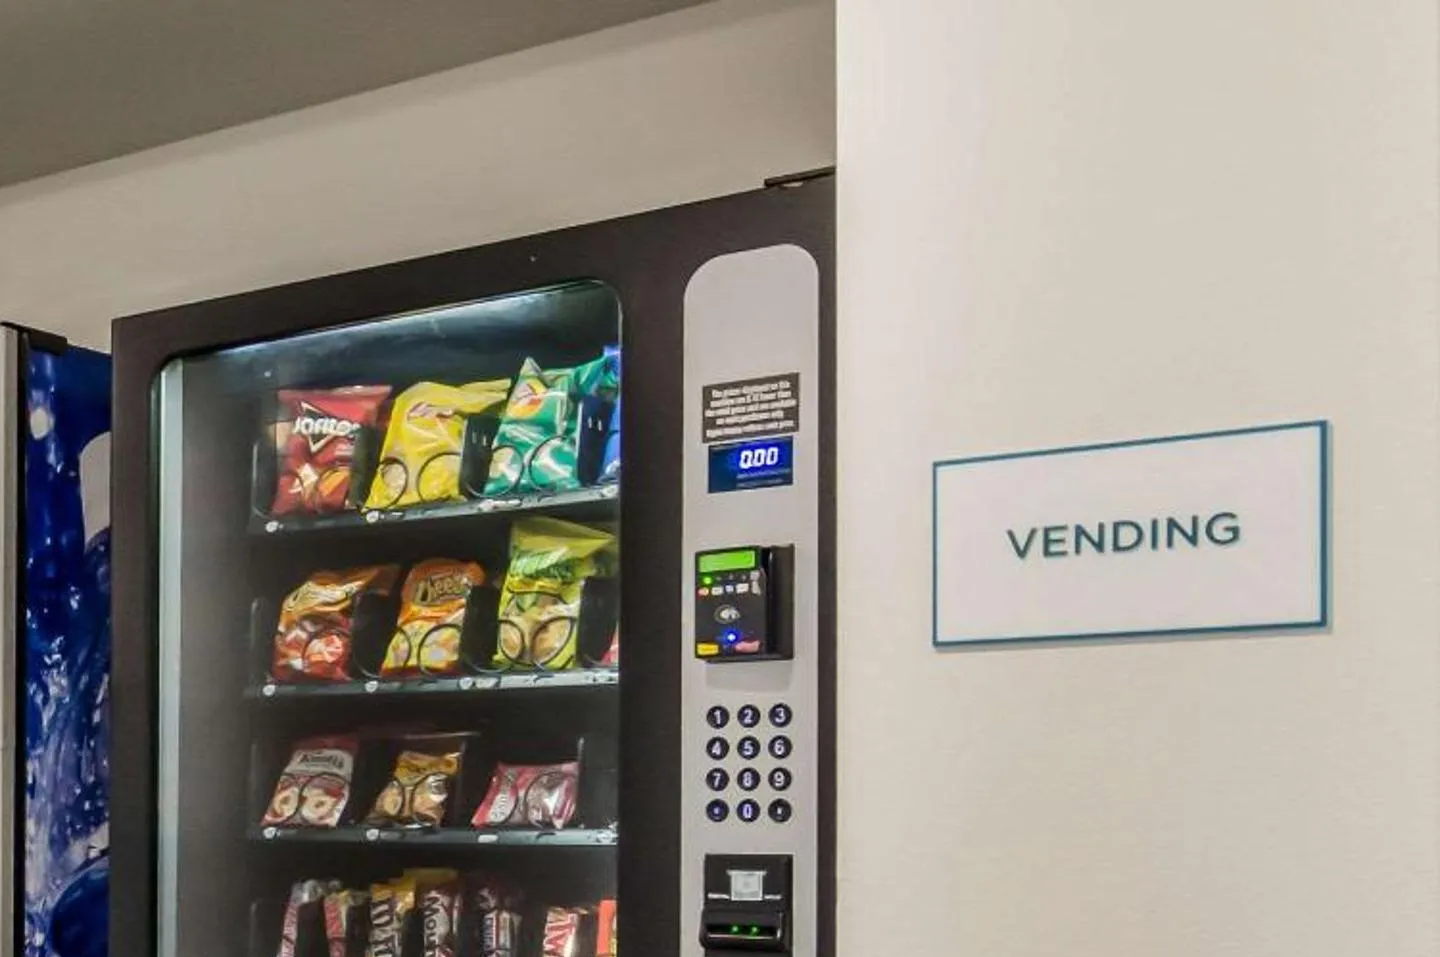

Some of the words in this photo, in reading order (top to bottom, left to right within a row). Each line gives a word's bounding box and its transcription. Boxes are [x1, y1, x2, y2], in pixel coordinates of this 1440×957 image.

[1006, 511, 1241, 559] VENDING
[713, 710, 721, 724] 1
[743, 709, 753, 724] 2
[775, 707, 786, 723] 3
[712, 741, 721, 755] 4
[743, 740, 754, 756] 5
[774, 740, 785, 755] 6
[713, 772, 721, 788] 7
[743, 771, 753, 788] 8
[774, 771, 785, 788] 9
[742, 803, 753, 819] 0
